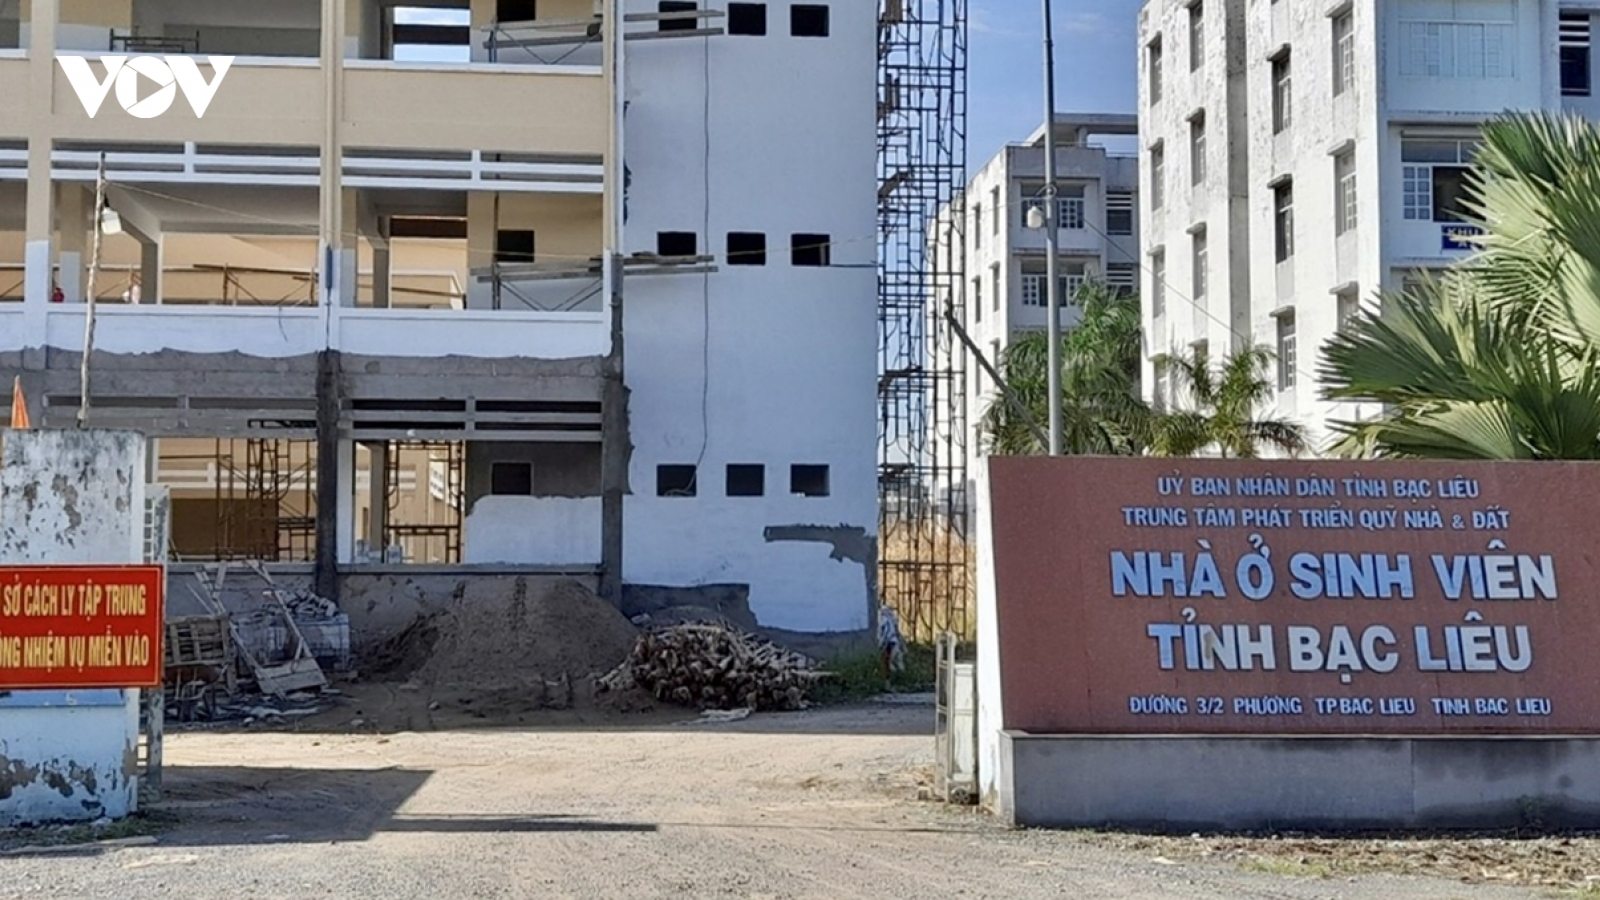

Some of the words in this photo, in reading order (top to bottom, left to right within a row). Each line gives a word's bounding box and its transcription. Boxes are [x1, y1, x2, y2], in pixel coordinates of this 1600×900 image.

[1157, 469, 1183, 495] UỶ
[1191, 478, 1231, 495] BAN
[1236, 472, 1289, 495] NHÂN
[1296, 473, 1335, 496] DÂN
[1342, 471, 1387, 497] TỈNH
[1393, 479, 1432, 503] BẠC
[1438, 474, 1479, 498] LIÊU
[1121, 507, 1187, 526] TRUNG
[1193, 503, 1236, 526] TÂM
[1241, 503, 1292, 527] PHÁT
[1299, 500, 1353, 528] TRIỂN
[1359, 505, 1397, 530] QUỸ
[1404, 505, 1443, 528] NHÀ
[1452, 514, 1465, 528] &
[1472, 505, 1509, 528] ĐẤT
[1110, 539, 1227, 597] NHÀ
[1236, 534, 1273, 600] Ở
[1289, 552, 1414, 599] SINH
[1431, 539, 1558, 600] VIÊN
[3, 574, 22, 616] SỞ
[23, 578, 58, 616] CÁCH
[61, 584, 75, 616] LY
[78, 578, 102, 621] TẬP
[105, 584, 146, 616] TRUNG
[0, 631, 21, 668] NG
[24, 629, 66, 673] NHIỆM
[69, 636, 86, 673] VỤ
[124, 629, 149, 667] VÀO
[1147, 607, 1276, 670] TỈNH
[1287, 625, 1399, 683] BẠC
[1414, 611, 1532, 672] LIÊU
[1196, 697, 1224, 714] 3/2
[1379, 698, 1415, 715] LIEU
[1432, 698, 1470, 714] TINH
[1474, 699, 1508, 714] BAC
[1515, 699, 1551, 715] LIEU
